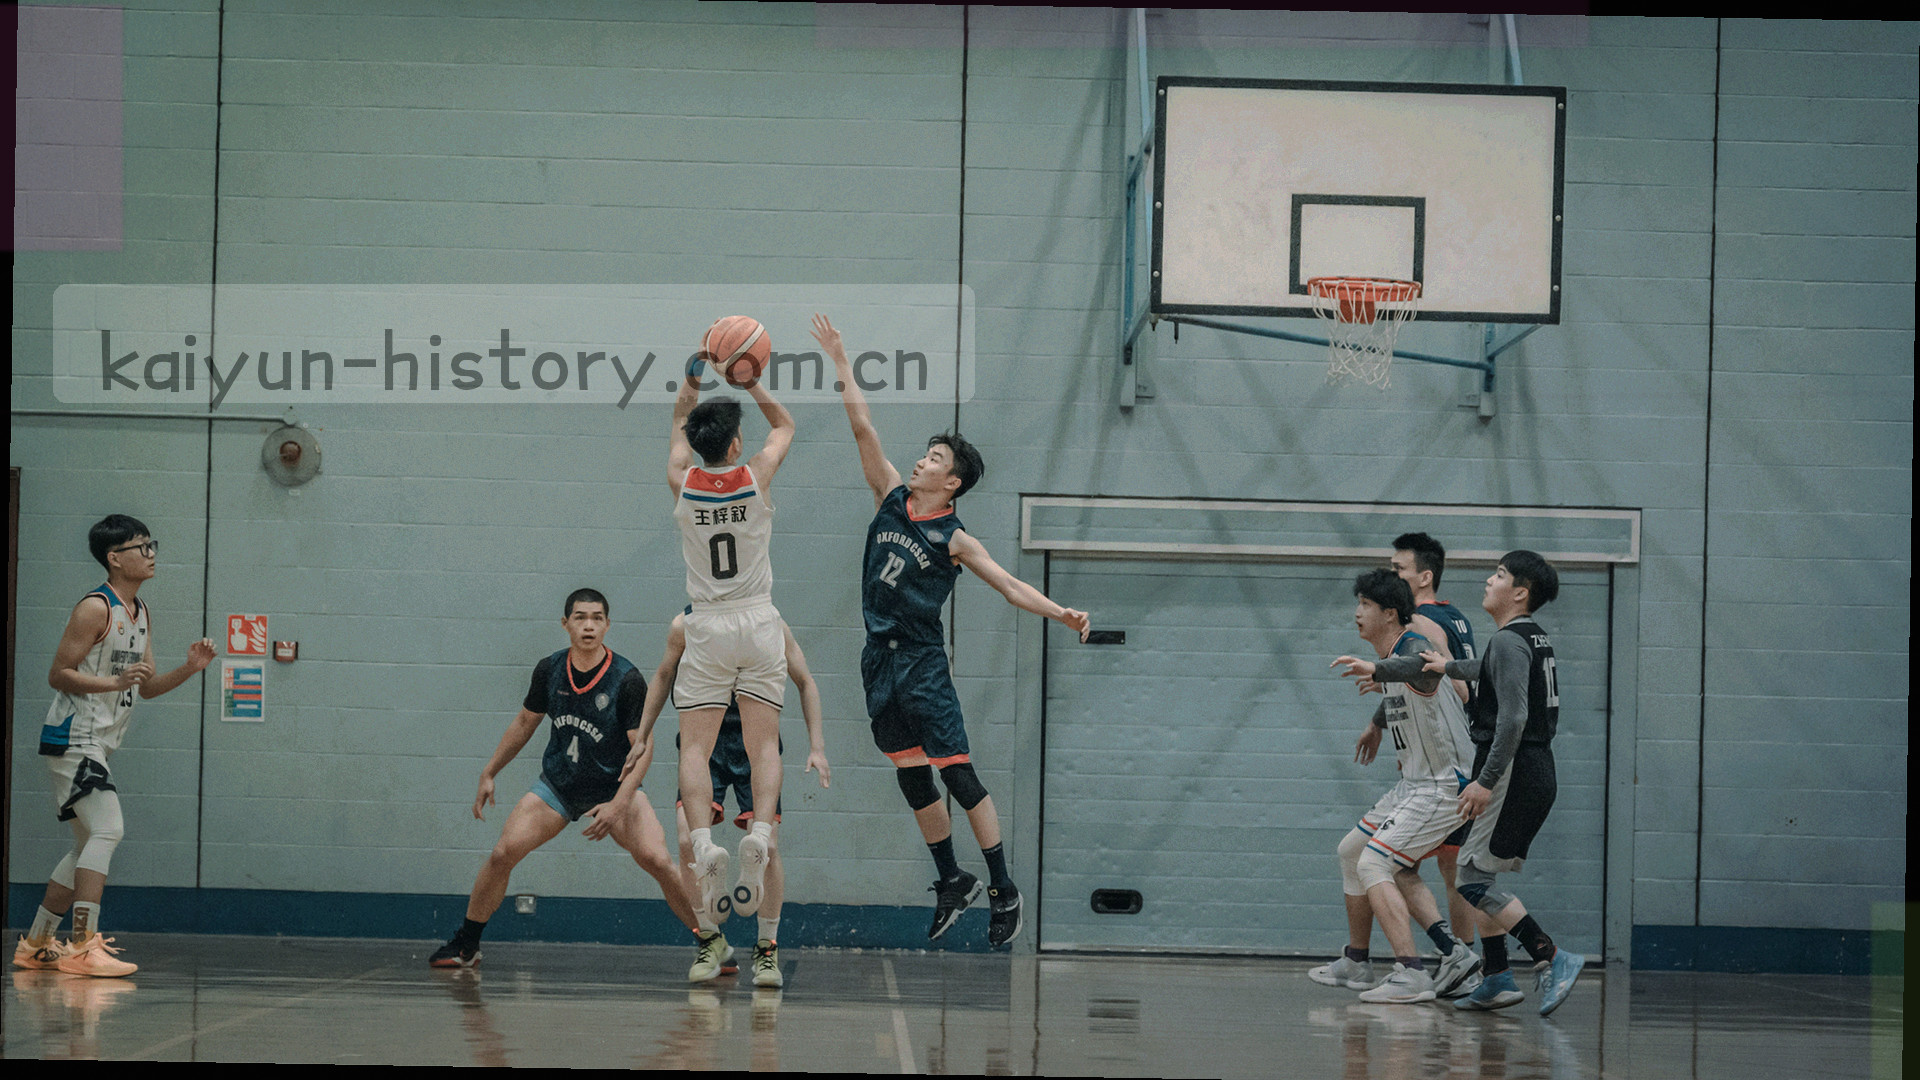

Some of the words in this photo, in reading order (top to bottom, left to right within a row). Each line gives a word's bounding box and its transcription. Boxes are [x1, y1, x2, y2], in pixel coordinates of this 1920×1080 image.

[708, 532, 739, 580] 0
[879, 551, 906, 589] 12
[566, 735, 579, 763] 4
